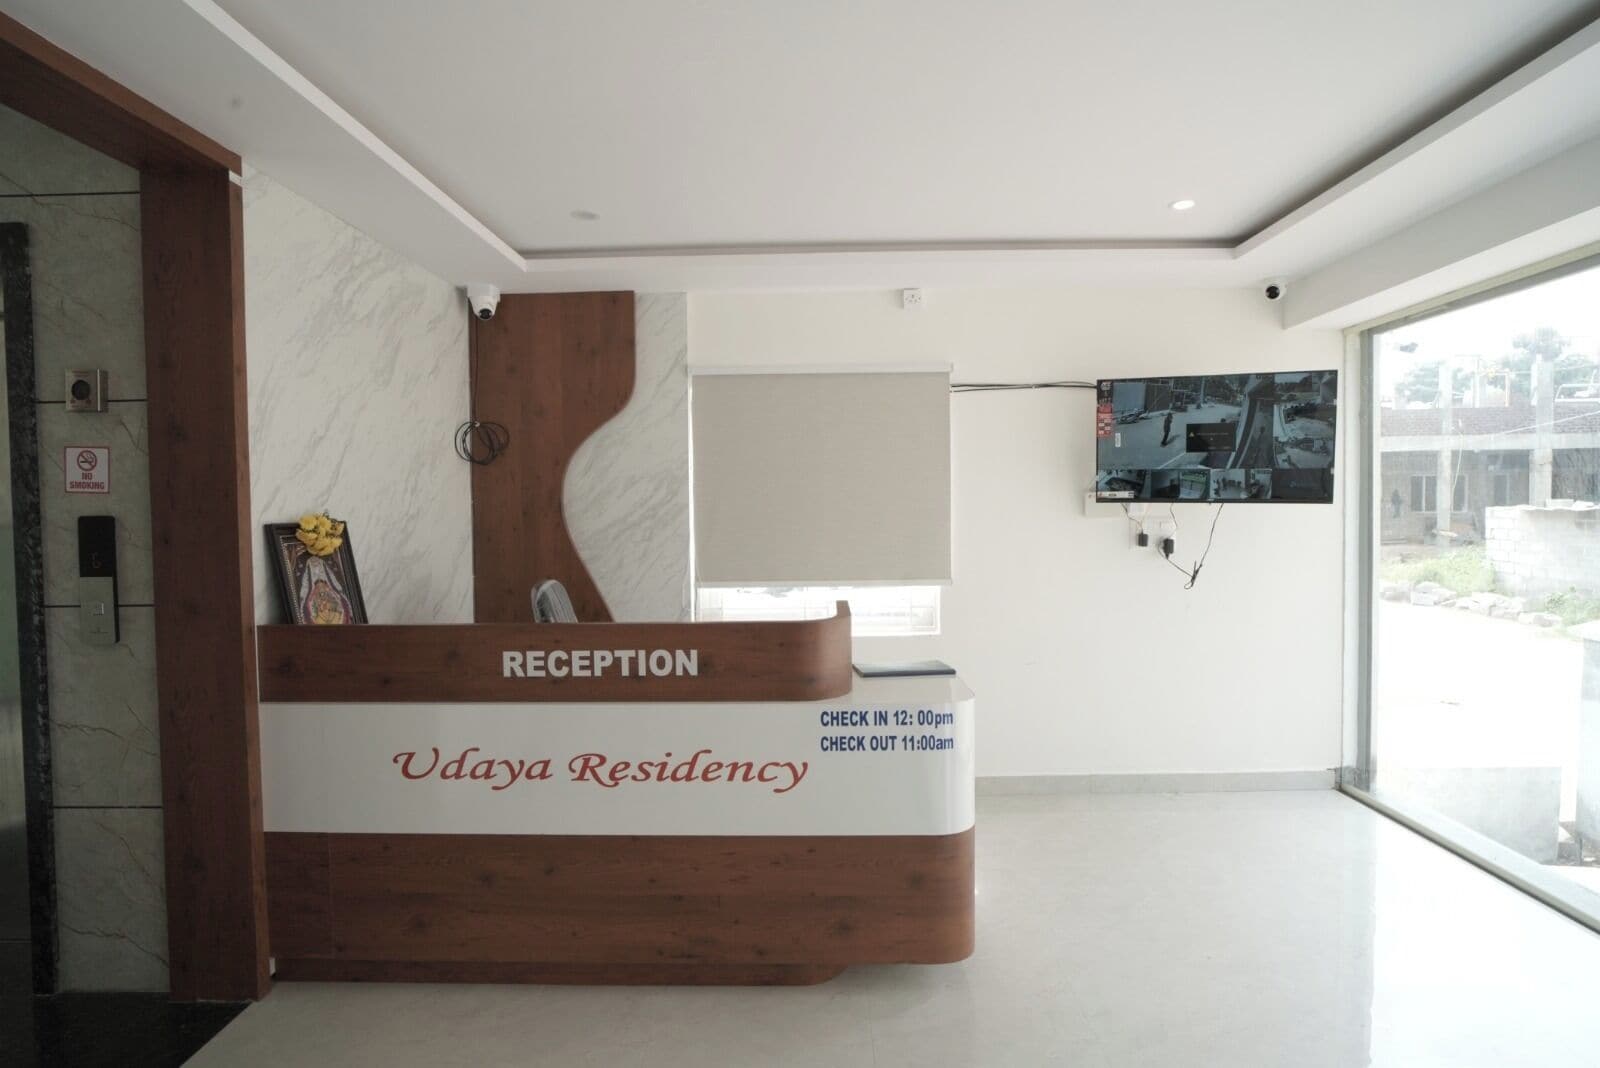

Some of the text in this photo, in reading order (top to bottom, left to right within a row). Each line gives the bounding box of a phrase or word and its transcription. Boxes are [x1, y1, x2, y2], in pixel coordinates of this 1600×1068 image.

[81, 472, 93, 480] NO
[70, 481, 104, 490] SMOKING
[502, 649, 698, 678] RECEPTION
[820, 710, 869, 726] CHECK
[873, 710, 889, 726] IN
[820, 734, 954, 752] CHECK OUT 11:00am
[393, 746, 809, 793] Udaya Residency
